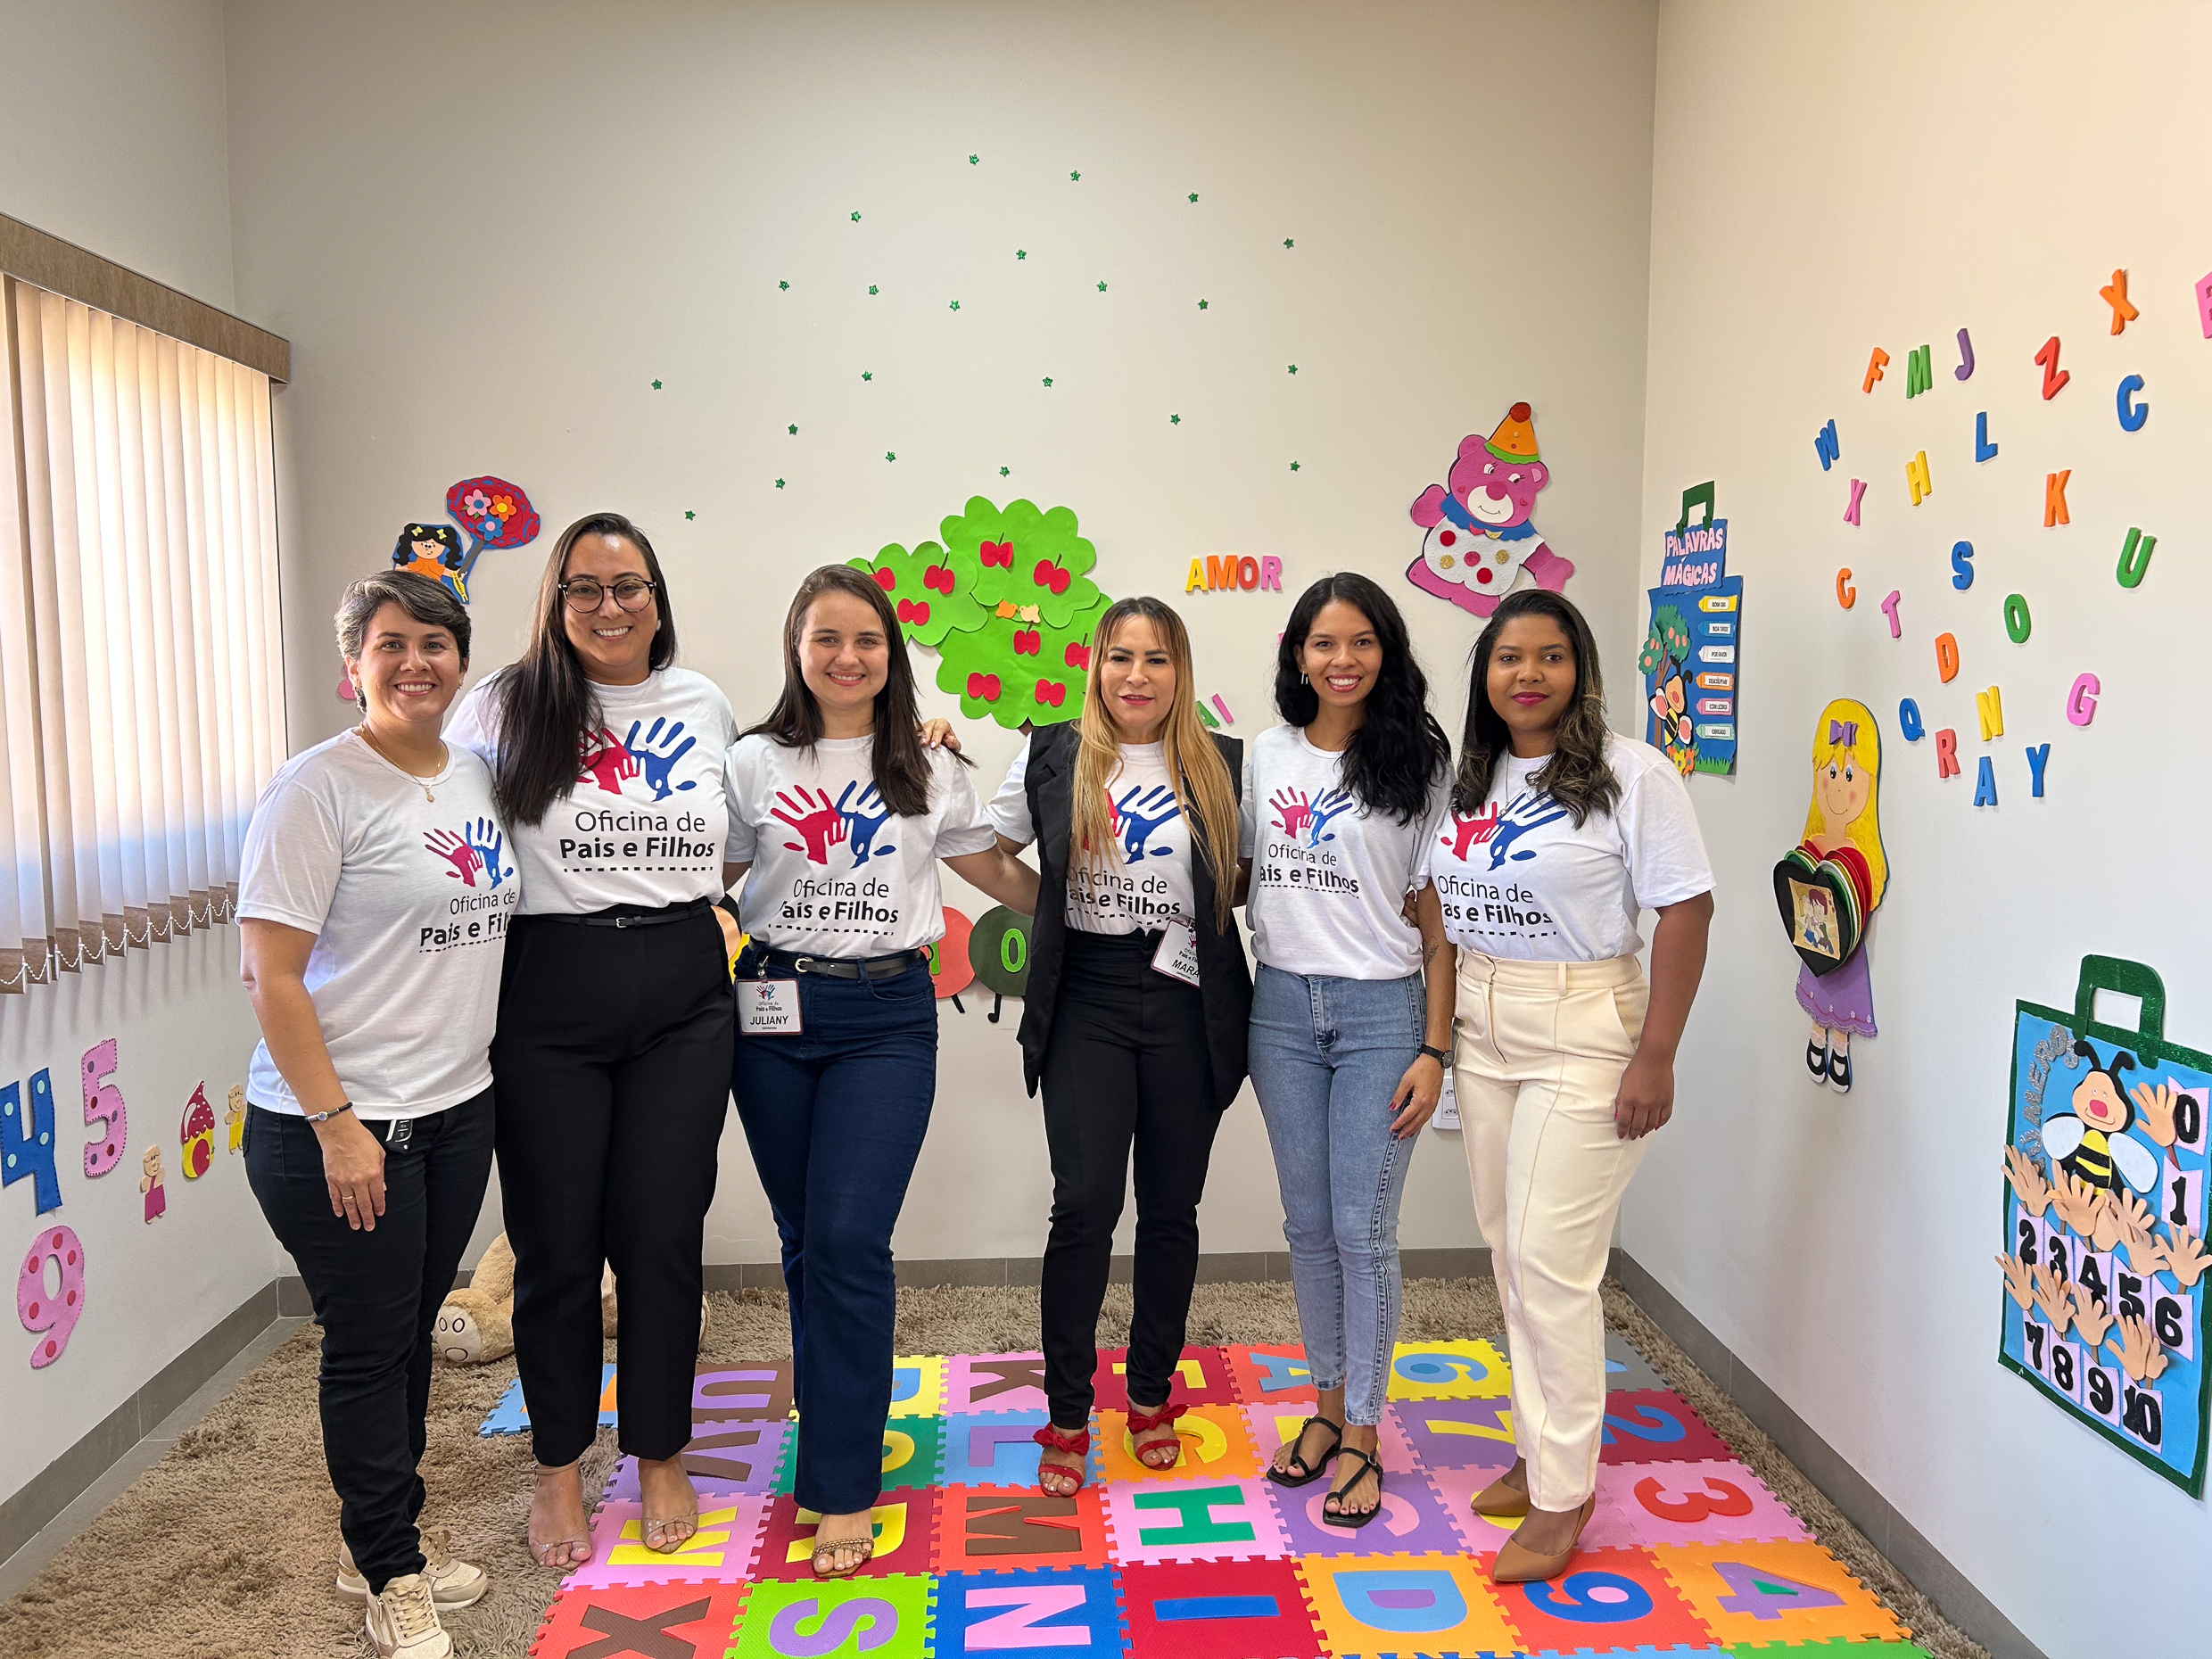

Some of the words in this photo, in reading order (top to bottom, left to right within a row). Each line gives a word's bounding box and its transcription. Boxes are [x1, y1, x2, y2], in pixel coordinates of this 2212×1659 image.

[2099, 268, 2139, 335] X
[1862, 347, 1890, 393] F
[1906, 344, 1932, 399] M
[1954, 328, 1975, 381] J
[2035, 336, 2070, 400] Z
[2117, 375, 2149, 432] C
[1814, 419, 1839, 471] W
[1976, 411, 1998, 463] L
[1844, 479, 1867, 526] X
[1905, 450, 1932, 507] H
[2043, 470, 2071, 527] K
[1666, 528, 1723, 557] PALAVRAS
[1952, 541, 1974, 590] S
[2117, 527, 2156, 588] U
[1184, 555, 1283, 592] AMOR
[1663, 556, 1718, 586] MÁGICAS
[1836, 568, 1855, 608] C
[1881, 590, 1901, 638] T
[2004, 594, 2031, 643] O
[1935, 632, 1960, 683] D
[1899, 698, 1925, 741] Q
[1976, 686, 2003, 741] N
[2067, 673, 2100, 726] G
[1936, 729, 1960, 778] R
[2026, 743, 2051, 797] Y
[1974, 756, 1997, 806] A
[575, 810, 668, 832] Oficina
[676, 812, 706, 832] de
[559, 837, 615, 858] Pais
[623, 841, 638, 857] e
[646, 837, 715, 858] Filhos
[1267, 844, 1316, 863] Oficina
[1321, 851, 1337, 866] de
[450, 893, 499, 915] Oficina
[503, 888, 516, 905] de
[793, 878, 856, 898] Oficina
[863, 877, 889, 898] de
[1067, 866, 1135, 892] Oficina
[1142, 876, 1168, 894] de
[1069, 887, 1096, 904] ais
[1099, 894, 1110, 907] e
[1117, 893, 1181, 915] Filhos
[1259, 863, 1282, 882] ais
[1290, 869, 1301, 882] e
[1306, 867, 1359, 893] Filhos
[1438, 875, 1500, 901] Oficina
[1506, 883, 1533, 903] de
[420, 922, 461, 947] Pais
[467, 921, 481, 937] e
[775, 901, 813, 919] ais
[818, 906, 830, 920] e
[834, 901, 899, 923] Filhos
[1465, 906, 1479, 921] e
[1484, 904, 1554, 927] Filhos
[750, 1016, 788, 1026] JULIANY
[81, 1037, 127, 1177] 5
[0, 1068, 62, 1217] 4
[2169, 1176, 2187, 1231] 1
[17, 1226, 85, 1369] 9
[2019, 1219, 2037, 1265] 2
[2049, 1235, 2068, 1285] 3
[2078, 1255, 2107, 1309] 4
[2118, 1273, 2145, 1324] 5
[2155, 1297, 2183, 1347] 6
[692, 1370, 778, 1408] U
[1393, 1352, 1489, 1383] 6
[2024, 1322, 2043, 1370] 7
[2052, 1345, 2073, 1391] 8
[2088, 1367, 2113, 1415] 9
[2123, 1385, 2161, 1445] 10
[1601, 1405, 1685, 1443] 2
[1133, 1485, 1256, 1546] H
[1634, 1477, 1753, 1523] 3
[966, 1497, 1082, 1556] M
[1332, 1570, 1468, 1632] D
[1712, 1562, 1847, 1620] 4
[566, 1596, 711, 1659] X
[769, 1597, 898, 1657] S
[964, 1585, 1091, 1651] N
